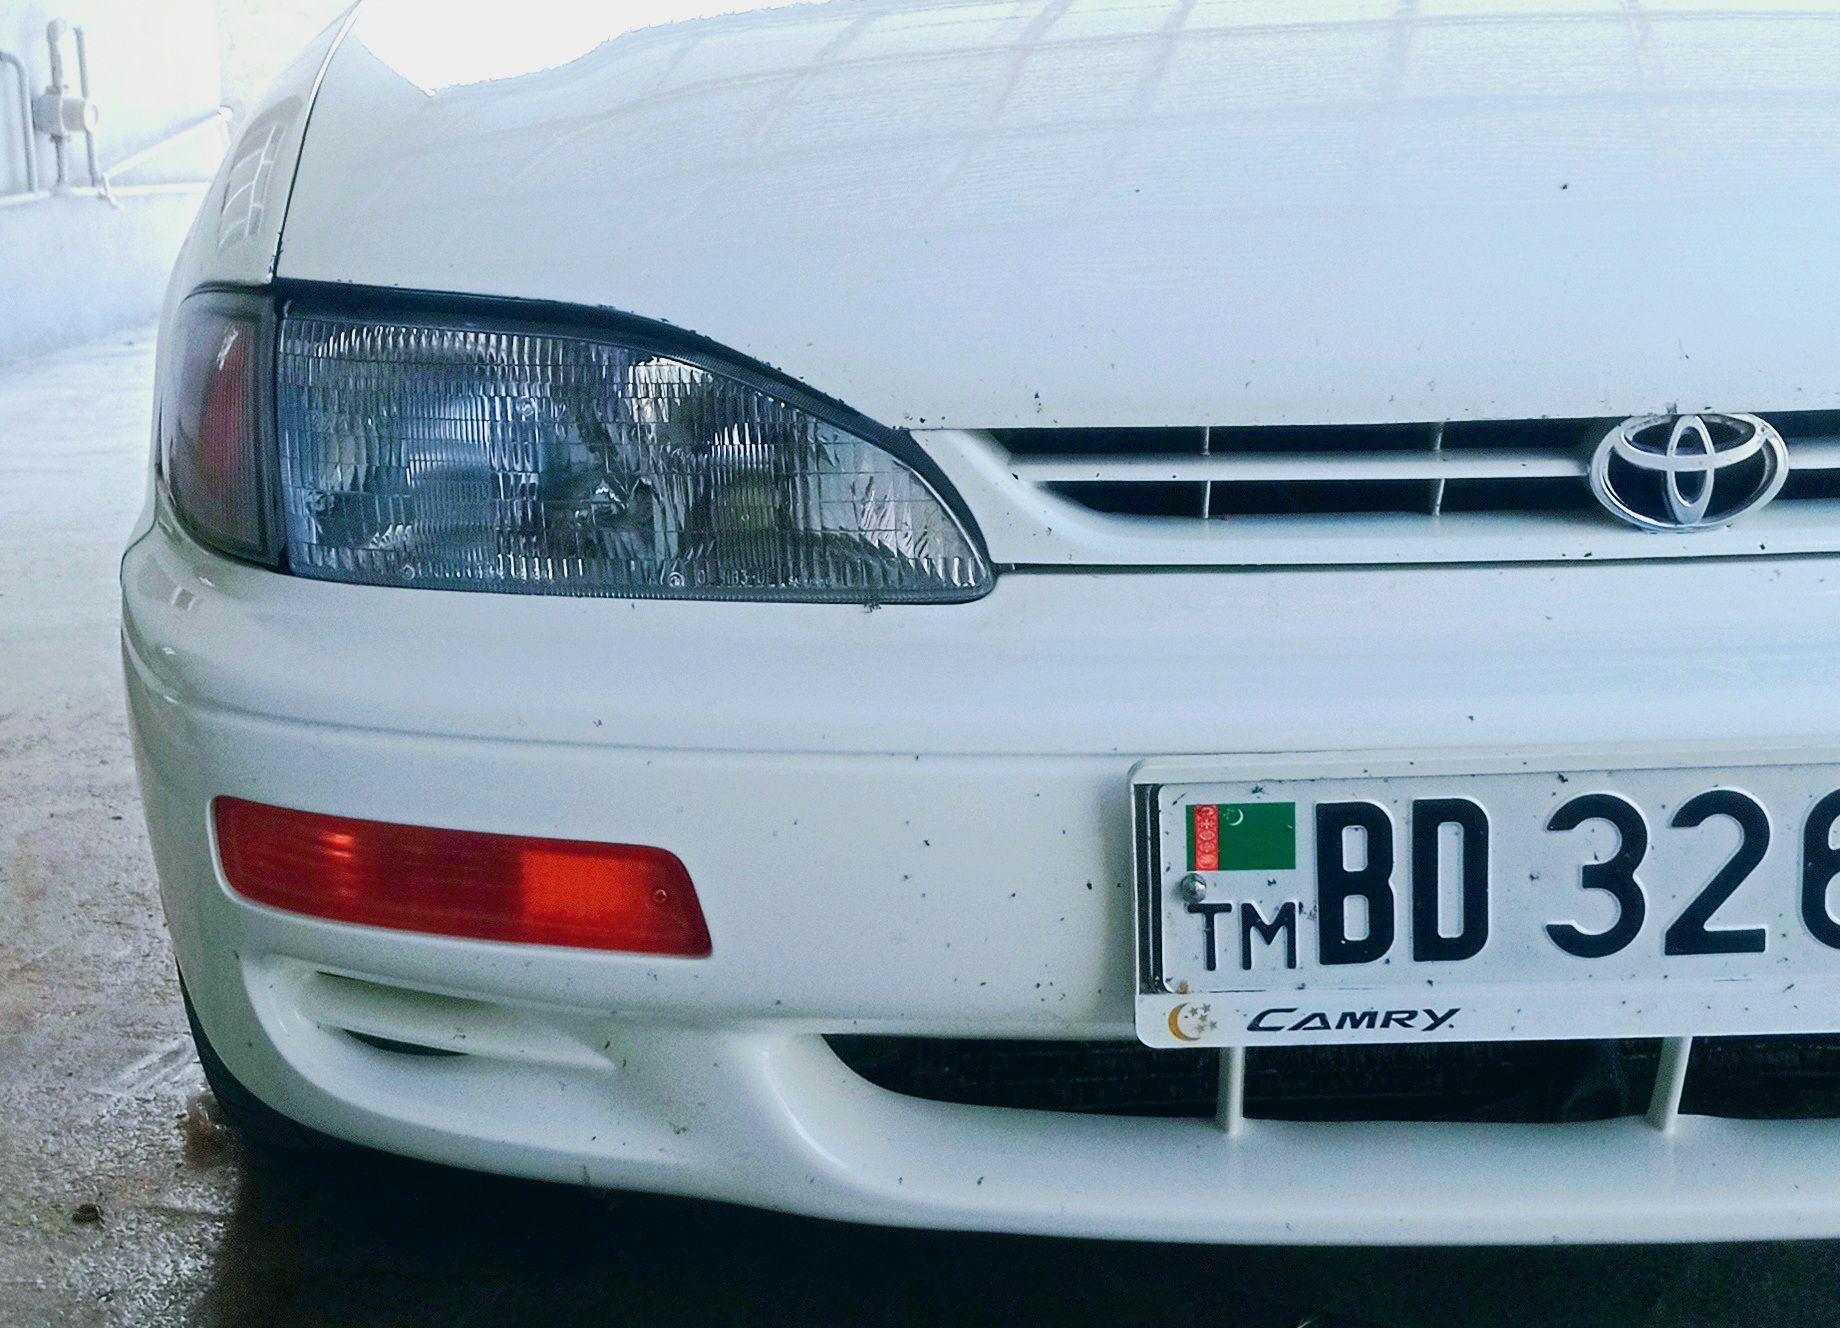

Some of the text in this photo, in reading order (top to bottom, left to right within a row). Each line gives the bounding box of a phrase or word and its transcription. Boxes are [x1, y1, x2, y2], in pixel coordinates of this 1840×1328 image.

[1186, 900, 1297, 971] TM
[1315, 798, 1490, 966] BD
[1247, 1007, 1461, 1032] CAMRY
